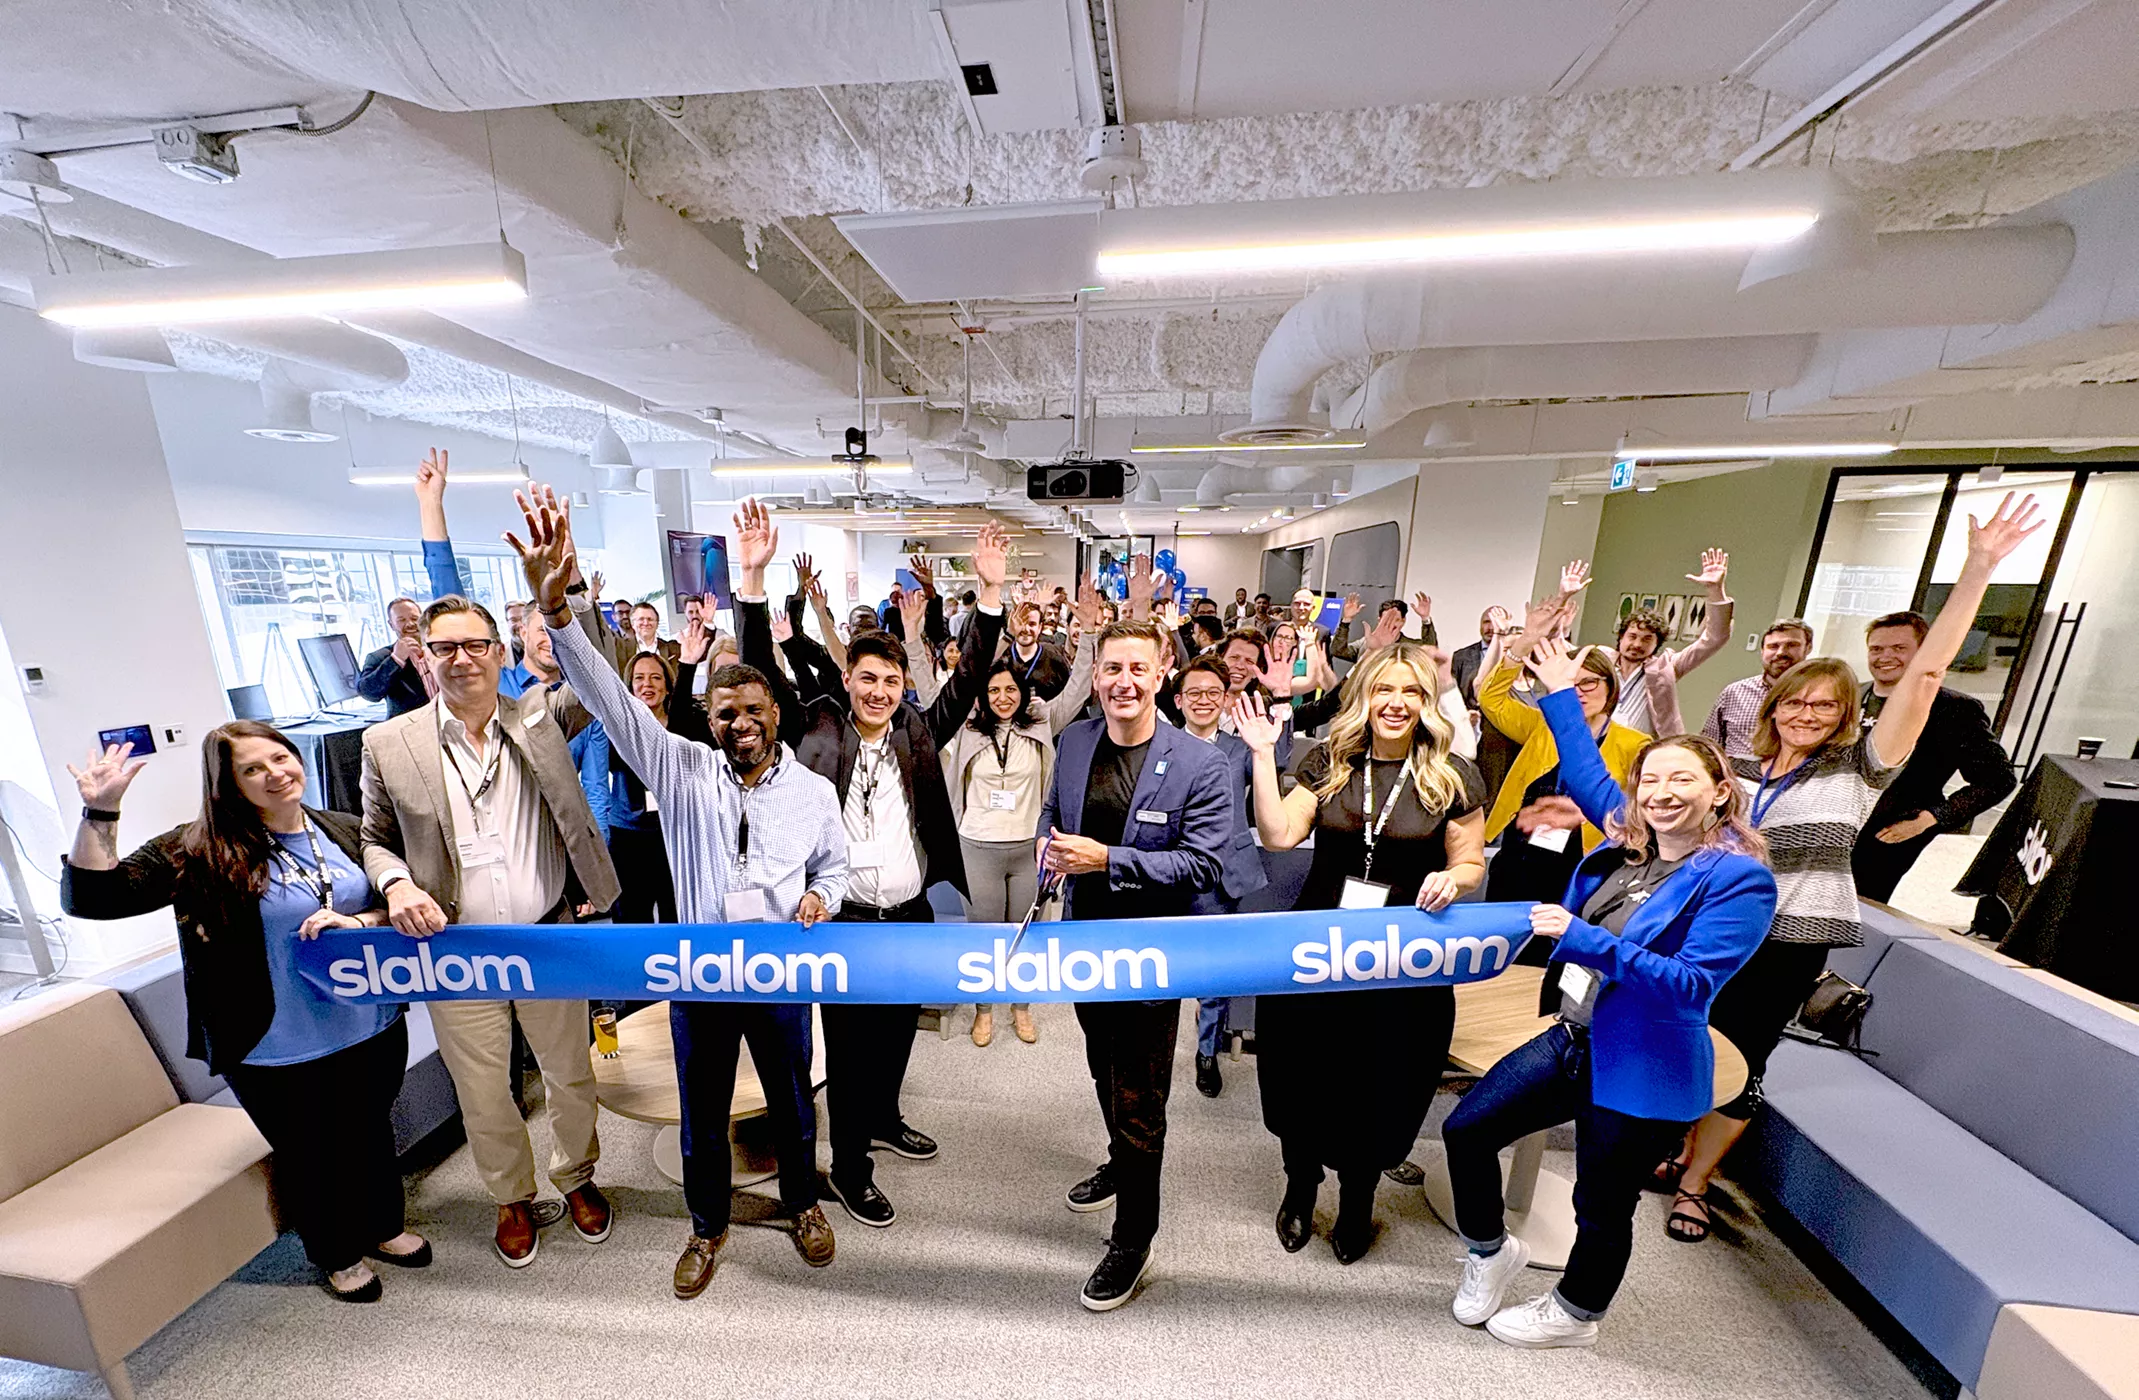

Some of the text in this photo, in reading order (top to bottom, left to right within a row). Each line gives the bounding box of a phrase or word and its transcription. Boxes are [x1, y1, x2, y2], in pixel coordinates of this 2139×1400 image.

[329, 943, 535, 997] slalom
[645, 939, 848, 993] slalom
[957, 937, 1169, 993] slalom
[1292, 923, 1510, 984] slalom
